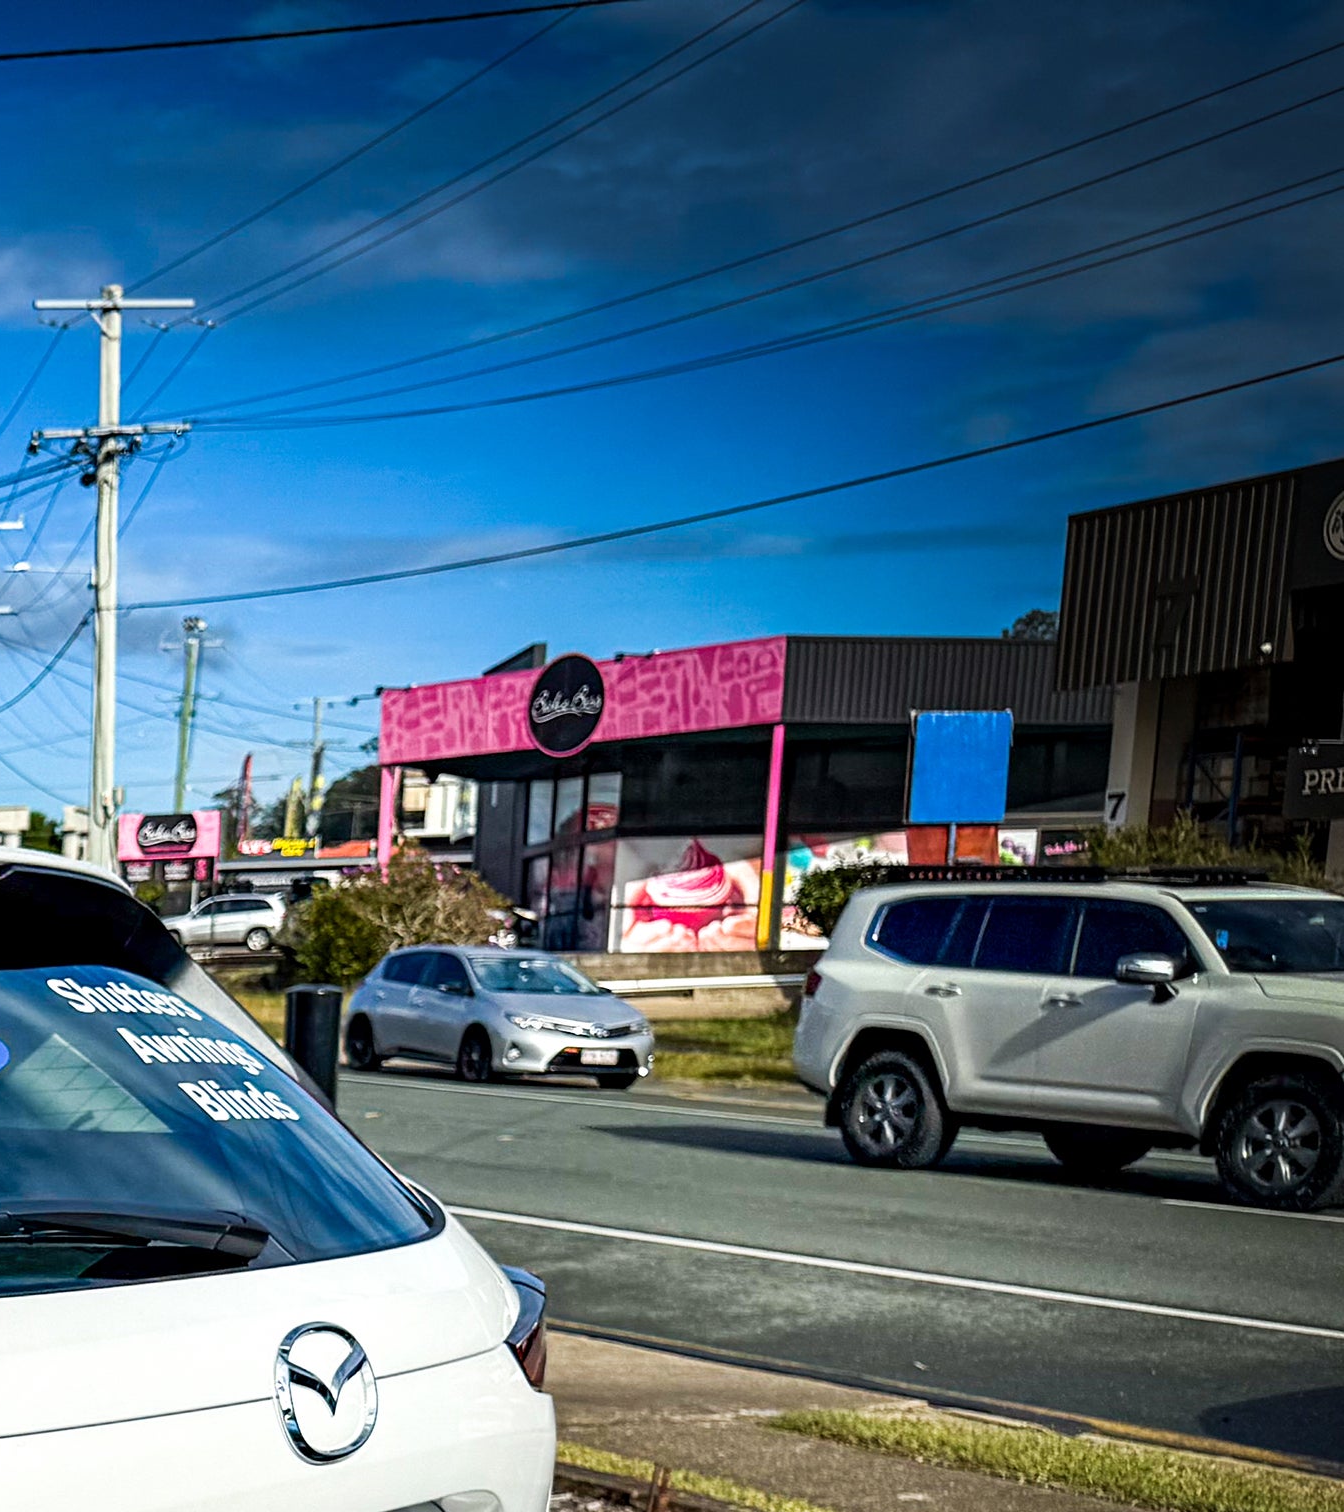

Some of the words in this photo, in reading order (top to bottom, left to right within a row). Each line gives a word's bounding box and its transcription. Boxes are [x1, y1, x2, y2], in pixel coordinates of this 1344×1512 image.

[1107, 791, 1126, 821] 7
[46, 977, 203, 1022] Shutters
[116, 1026, 265, 1076] Awnings
[177, 1079, 300, 1122] Blinds
